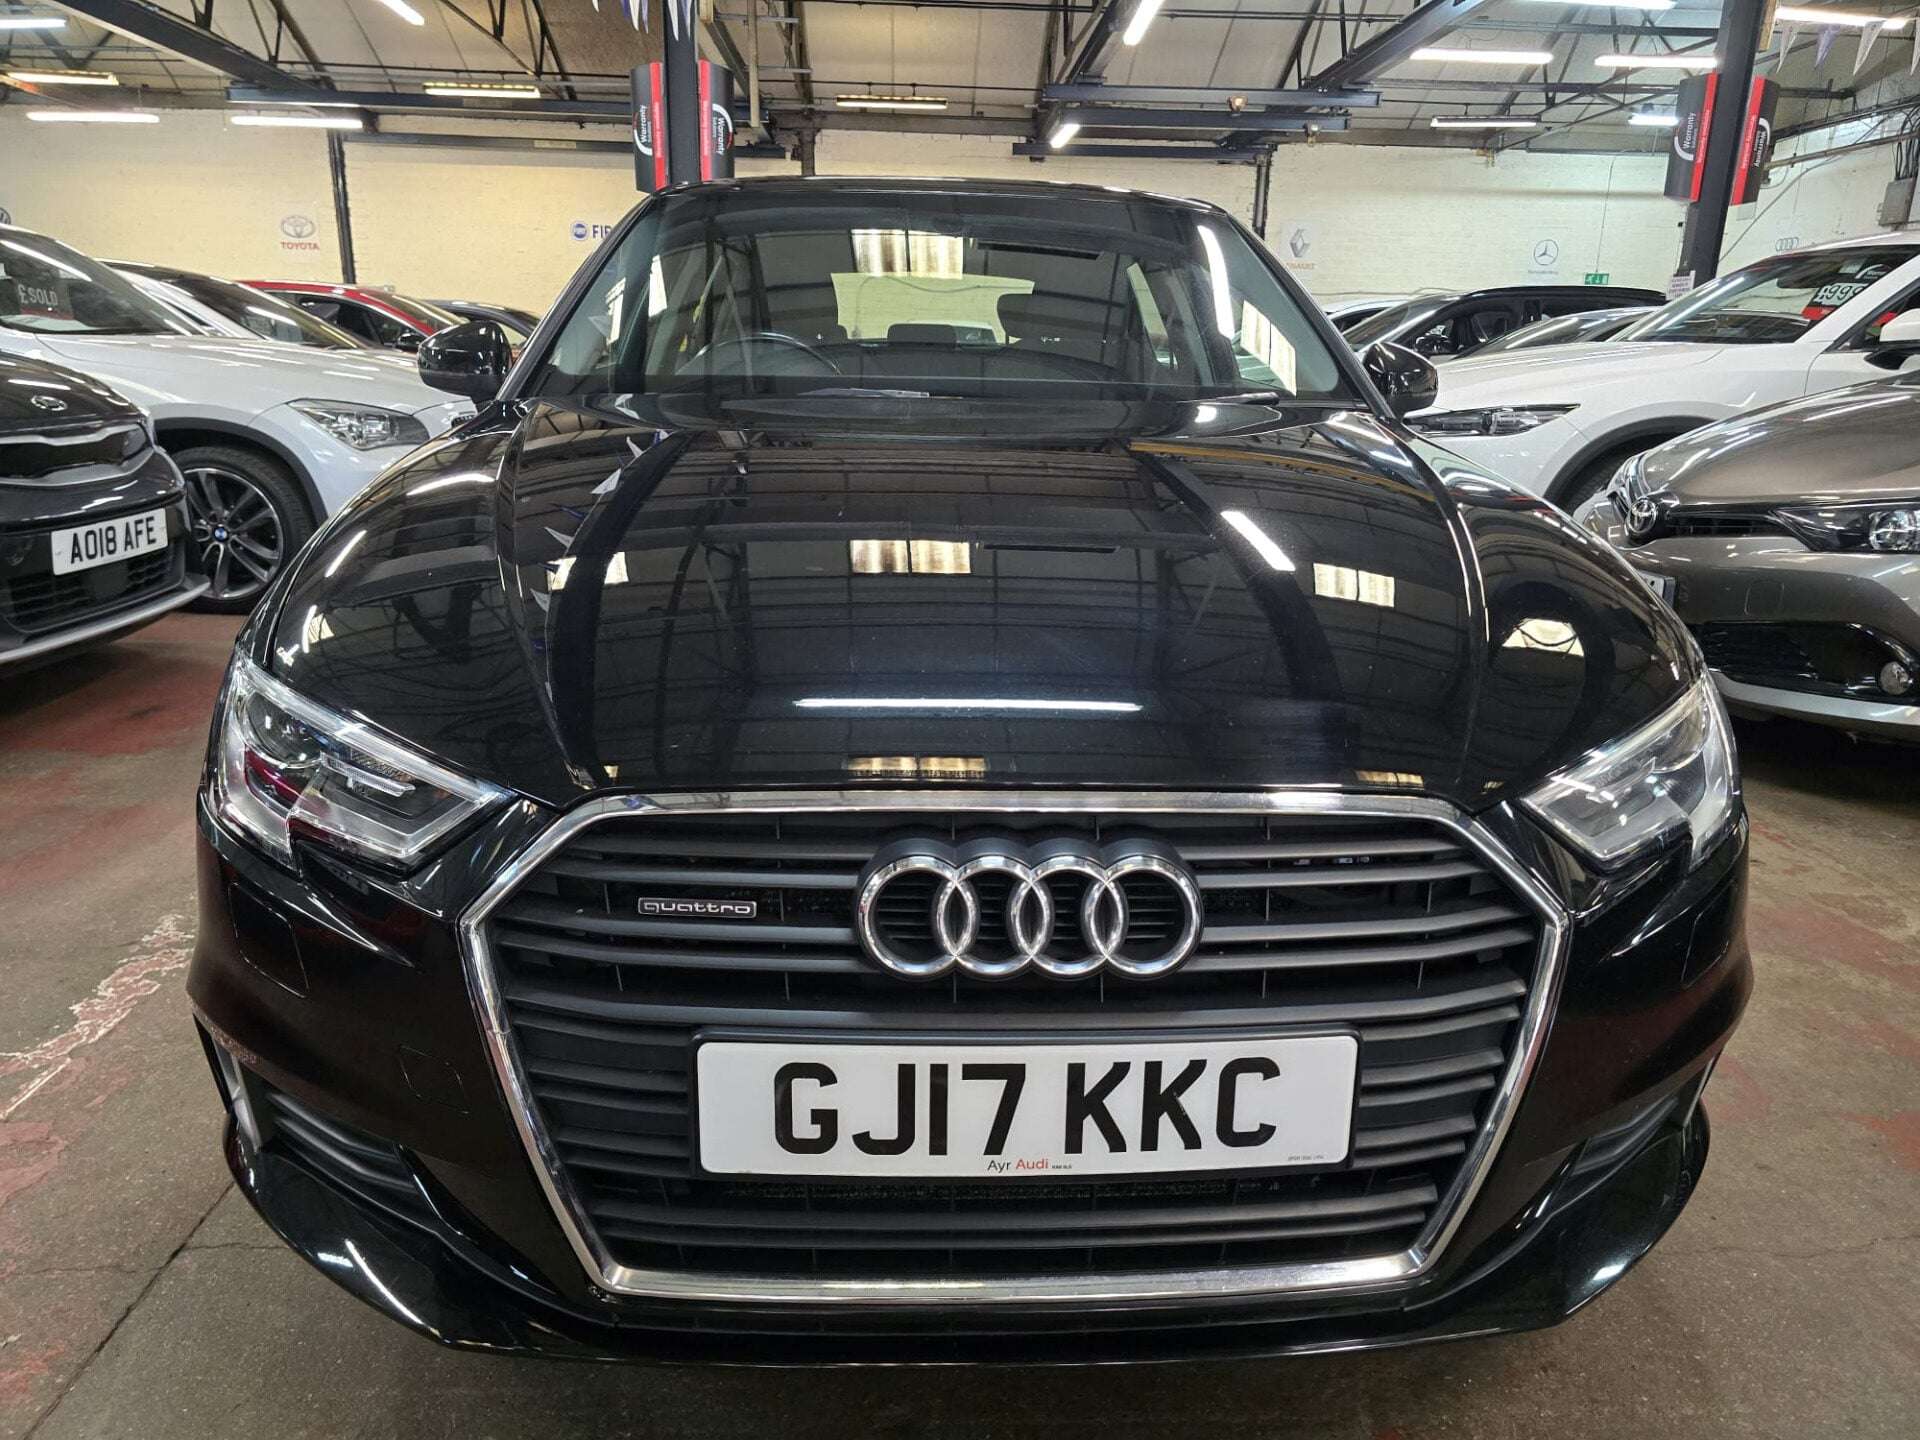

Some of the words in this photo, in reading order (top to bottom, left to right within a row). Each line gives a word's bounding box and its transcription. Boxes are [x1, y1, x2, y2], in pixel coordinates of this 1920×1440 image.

[639, 104, 648, 143] Warranty
[716, 117, 725, 156] Warranty
[1682, 112, 1696, 149] Warranty
[280, 241, 320, 250] TOYOTA
[70, 525, 117, 565] AO18
[124, 516, 157, 552] AFE
[643, 902, 751, 914] quattro
[773, 1062, 1026, 1156] GJ17
[1064, 1057, 1281, 1154] KKC
[988, 1160, 1011, 1173] Ayr
[1016, 1158, 1049, 1170] Audi
